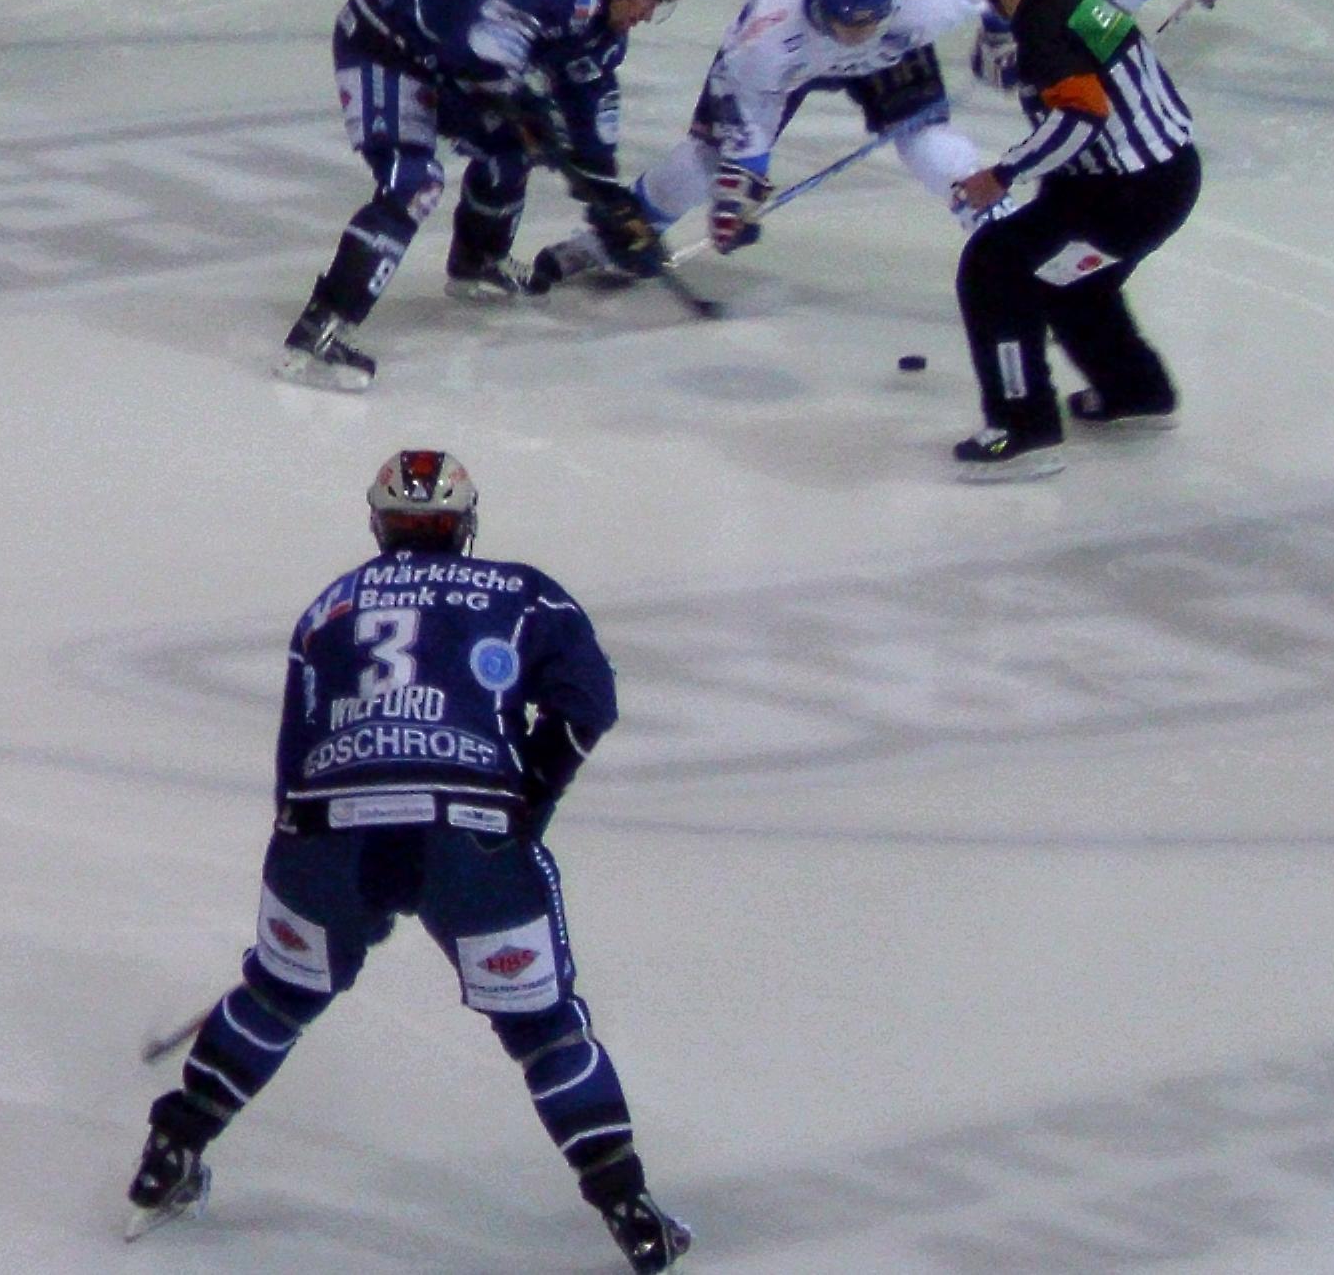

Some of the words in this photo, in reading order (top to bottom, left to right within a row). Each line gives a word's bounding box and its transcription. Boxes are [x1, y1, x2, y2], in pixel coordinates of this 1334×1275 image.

[362, 563, 525, 593] Märkische
[358, 585, 437, 610] Bank
[444, 591, 492, 611] eG
[353, 607, 422, 699] 3
